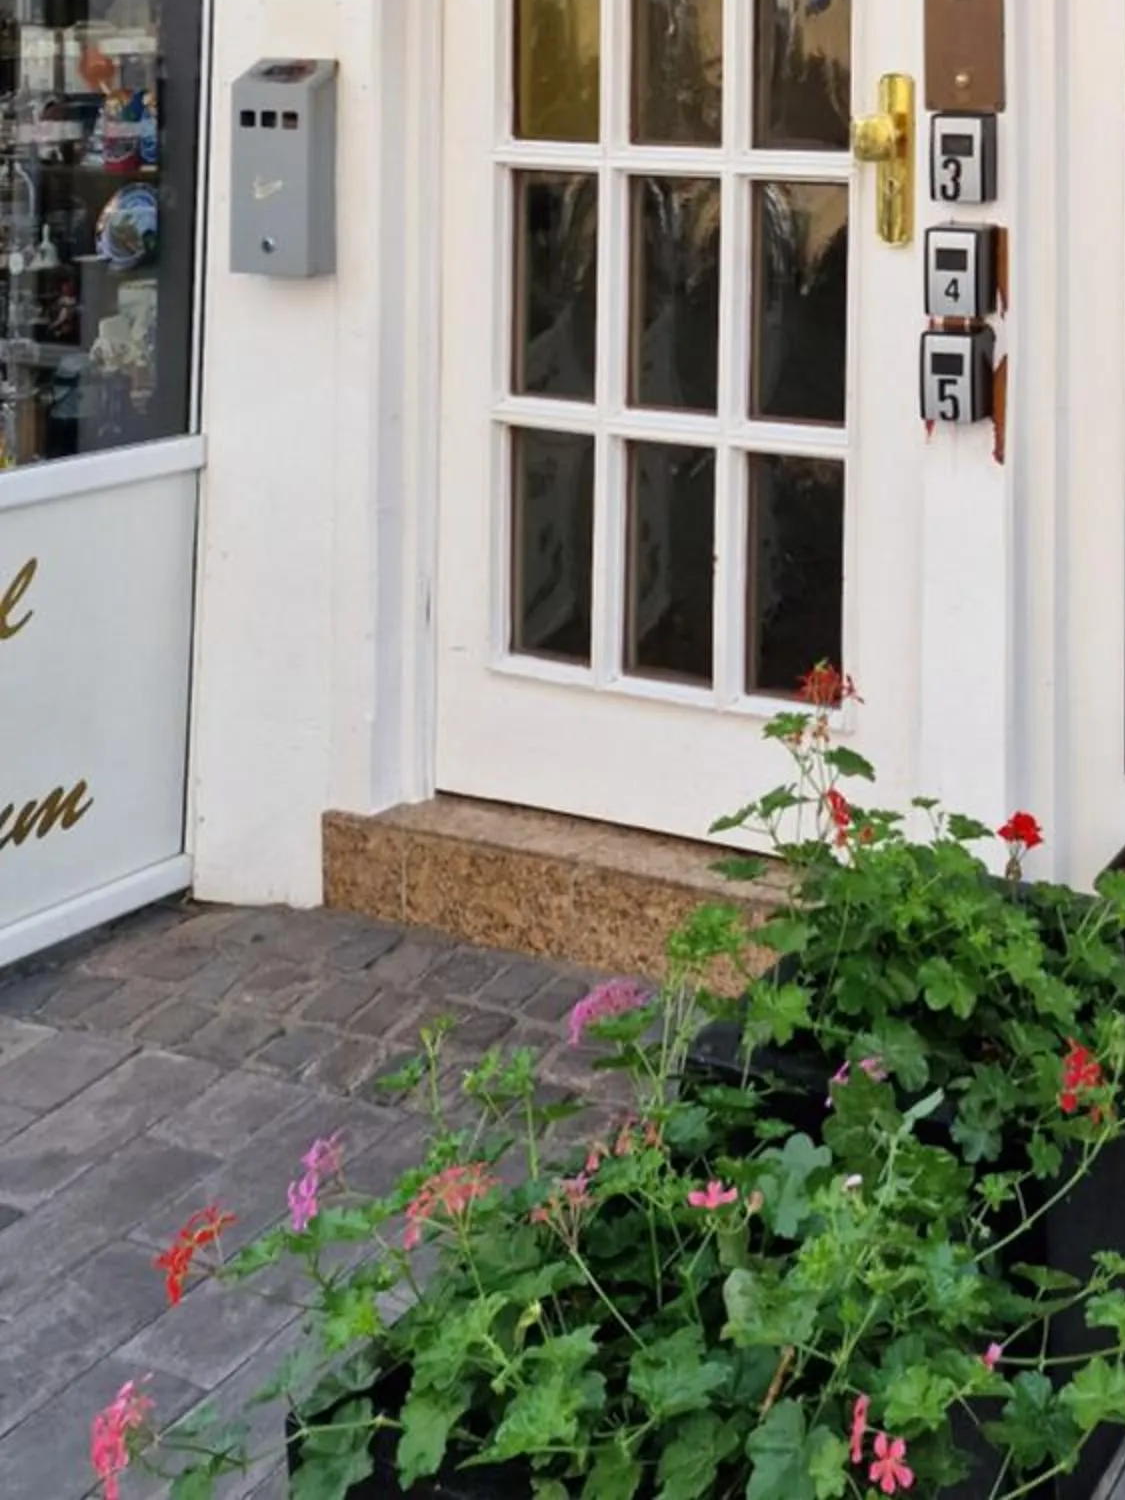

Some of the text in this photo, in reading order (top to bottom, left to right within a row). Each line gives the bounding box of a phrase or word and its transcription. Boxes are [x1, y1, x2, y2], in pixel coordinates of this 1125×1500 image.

[940, 157, 962, 201] 3
[944, 278, 961, 303] 4
[938, 378, 961, 423] 5
